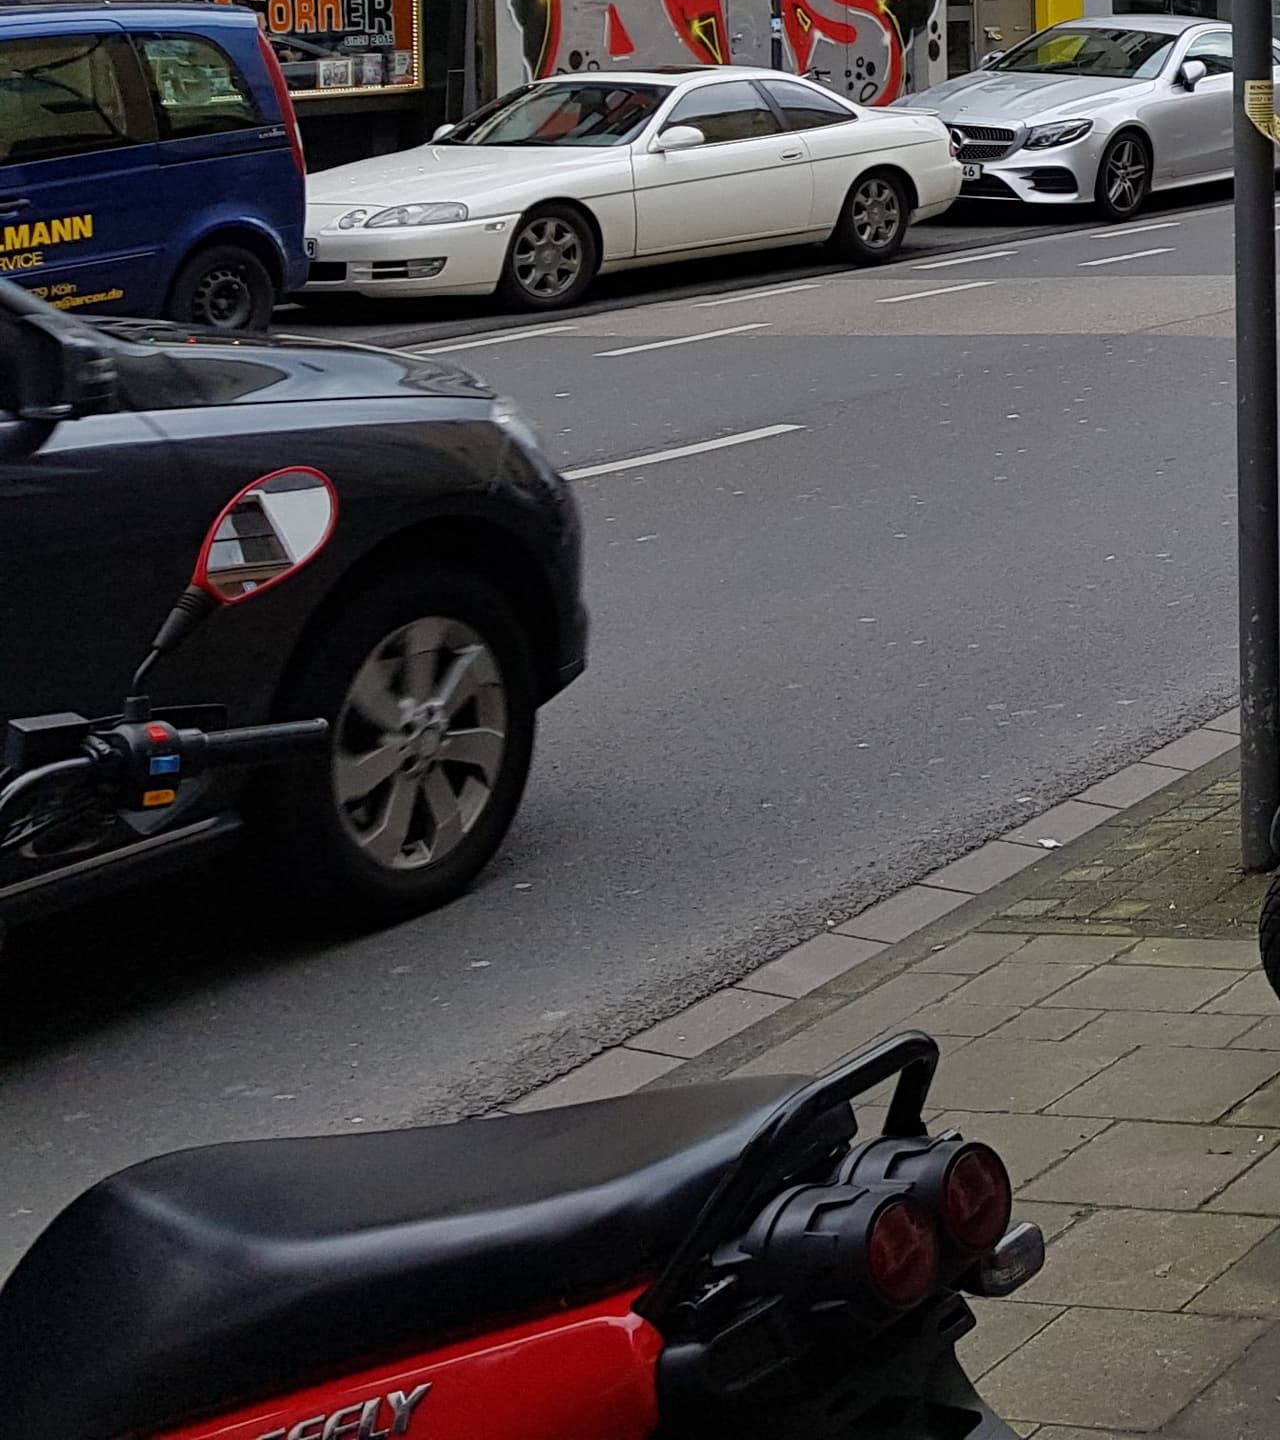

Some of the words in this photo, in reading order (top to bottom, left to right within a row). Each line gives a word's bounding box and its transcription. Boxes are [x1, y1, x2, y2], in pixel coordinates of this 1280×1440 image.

[370, 34, 393, 46] 2015
[0, 214, 93, 252] MANN
[255, 1382, 433, 1440] EELY
